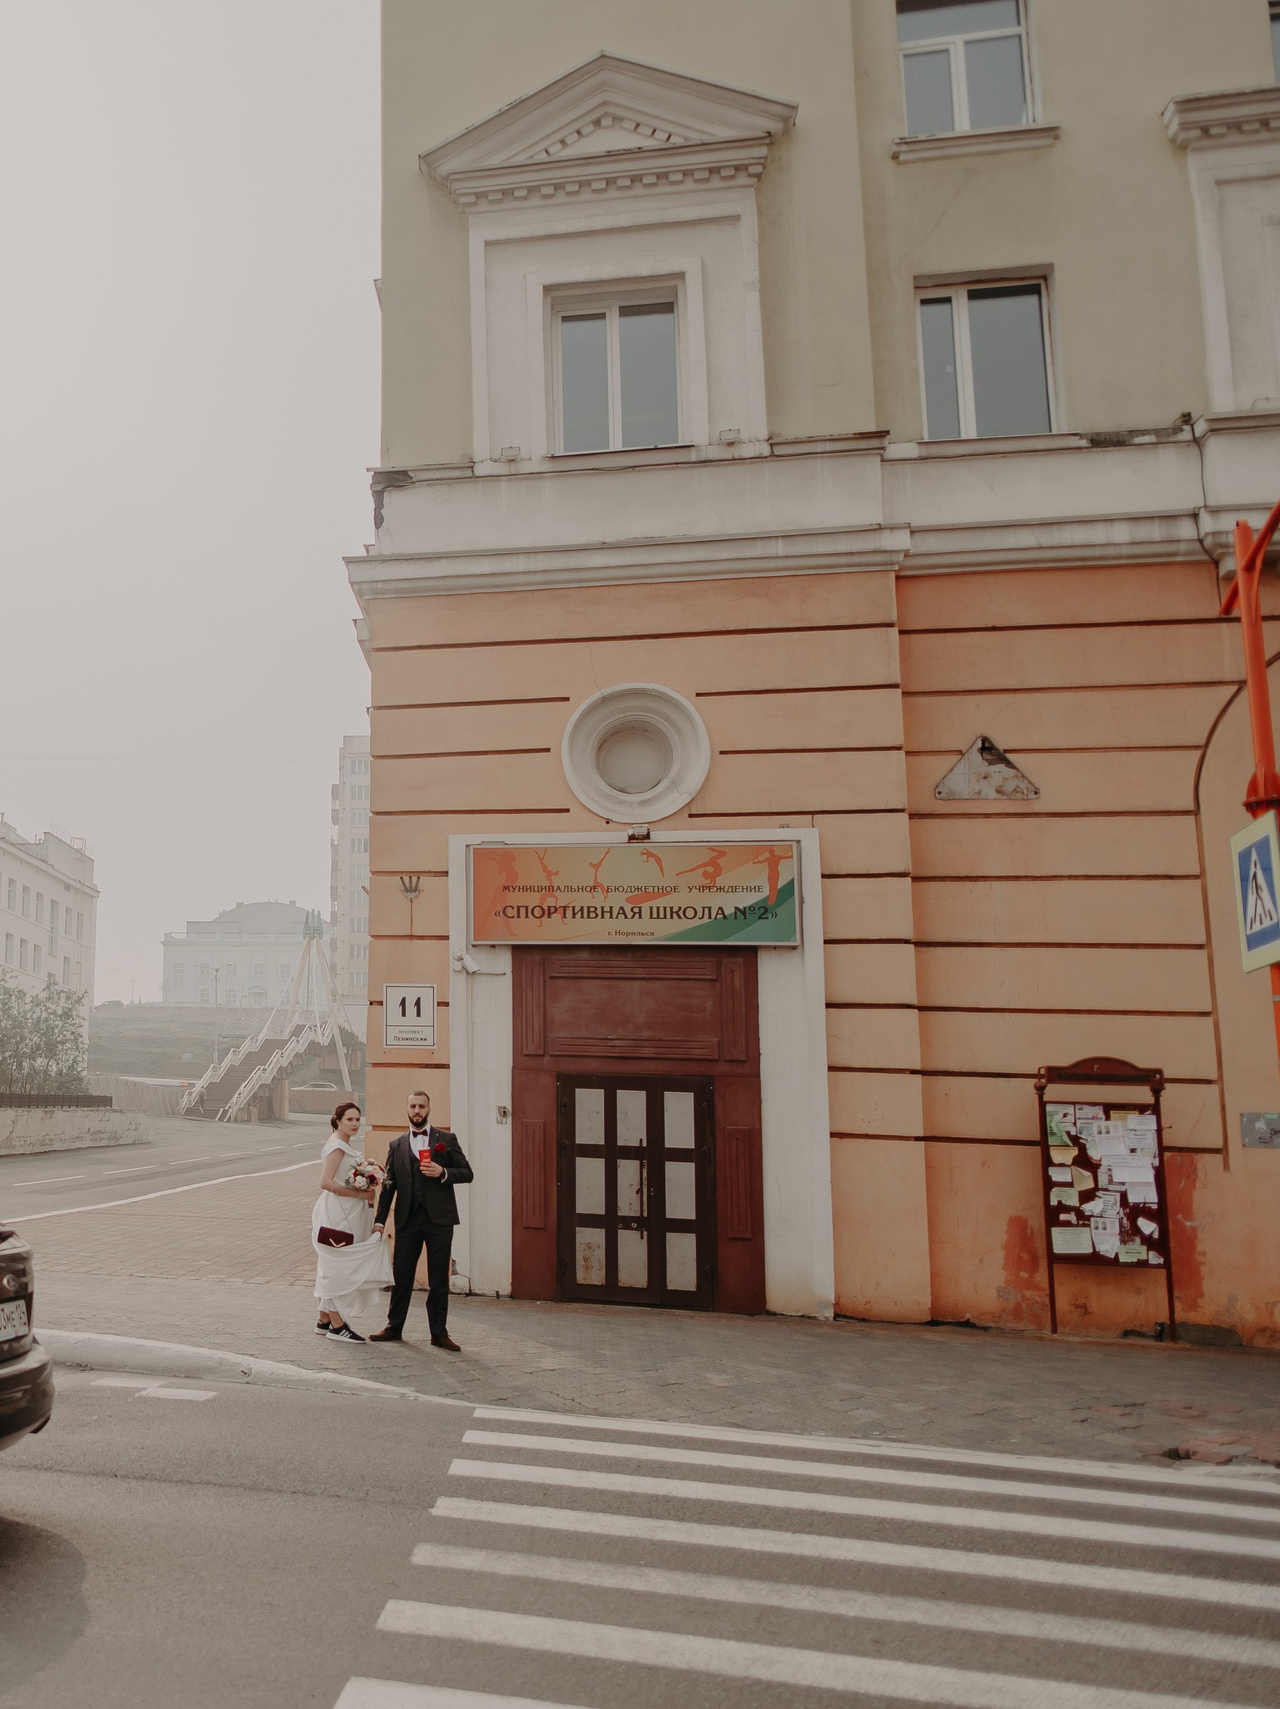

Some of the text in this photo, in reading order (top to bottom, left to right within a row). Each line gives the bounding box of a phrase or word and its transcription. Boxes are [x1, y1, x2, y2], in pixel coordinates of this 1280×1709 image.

[502, 884, 765, 894] МУНИЦИПАЛЬНОЕ БЮДЖЕТНОЕ УЧРЕЖДЕНИЕ
[494, 905, 643, 920] «СПОРТИВНАЯ
[648, 905, 728, 920] ШКОЛА
[614, 929, 655, 937] Норильск
[398, 996, 422, 1018] 11
